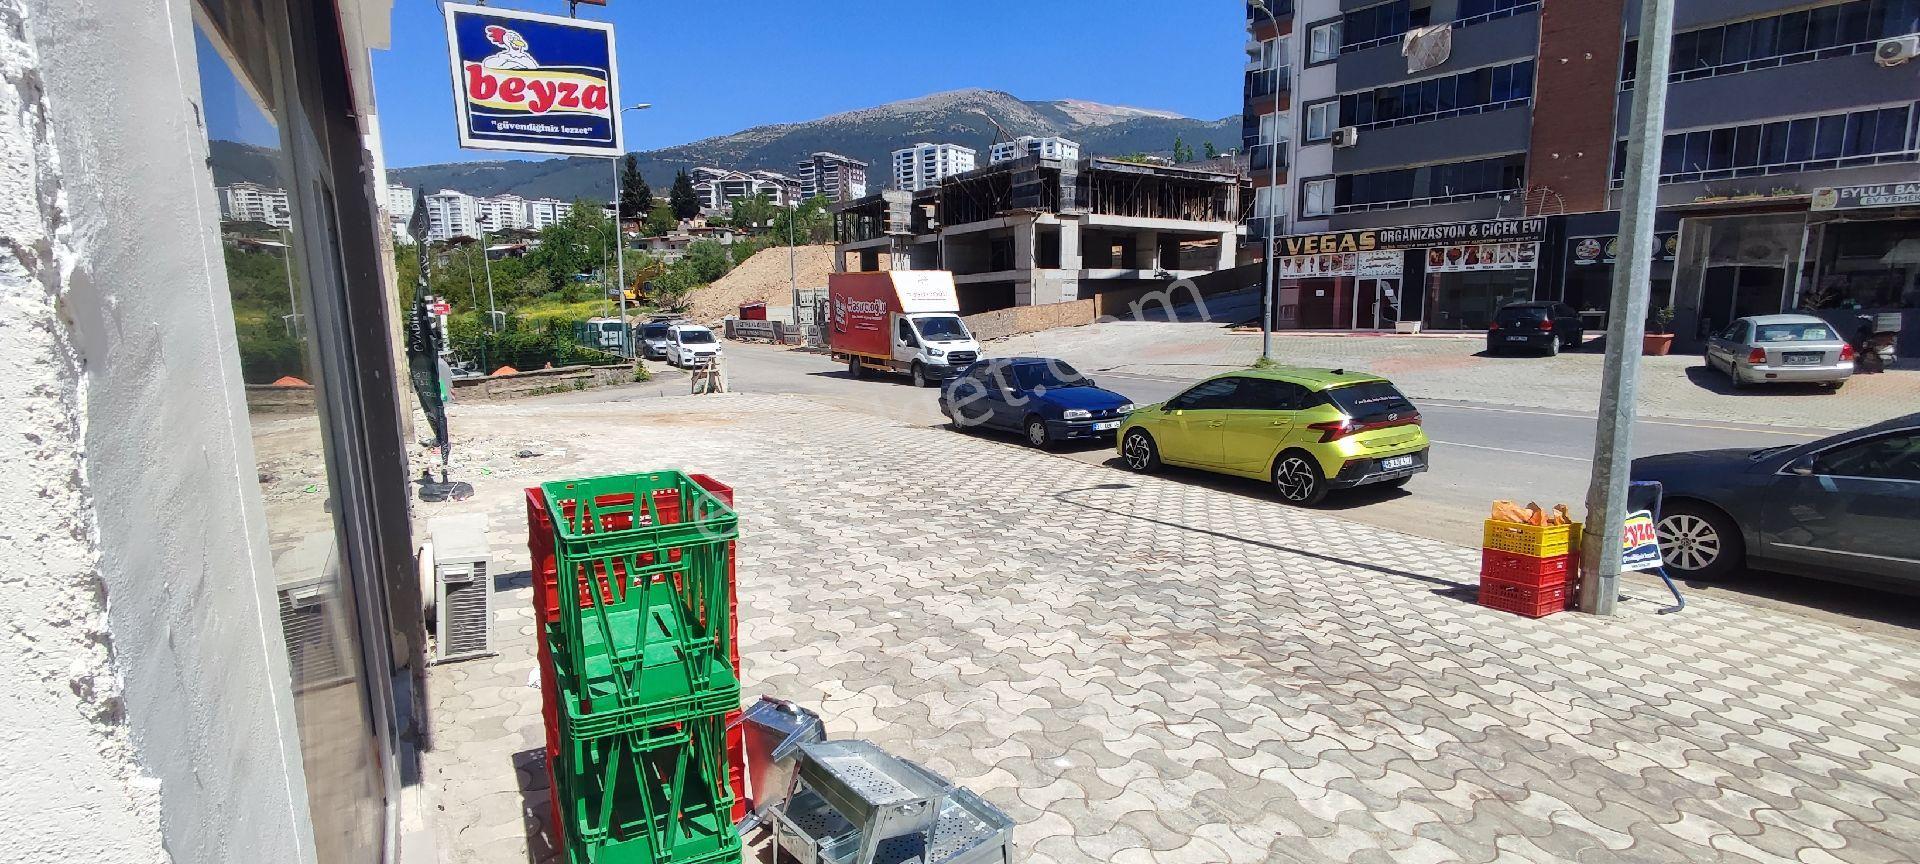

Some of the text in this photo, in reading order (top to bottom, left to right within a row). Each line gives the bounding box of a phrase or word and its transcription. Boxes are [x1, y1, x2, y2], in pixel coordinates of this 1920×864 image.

[466, 64, 608, 113] beyza
[1895, 183, 1920, 195] BA
[1469, 224, 1478, 236] &
[1286, 231, 1376, 255] VEGAS
[1624, 523, 1655, 547] eyza
